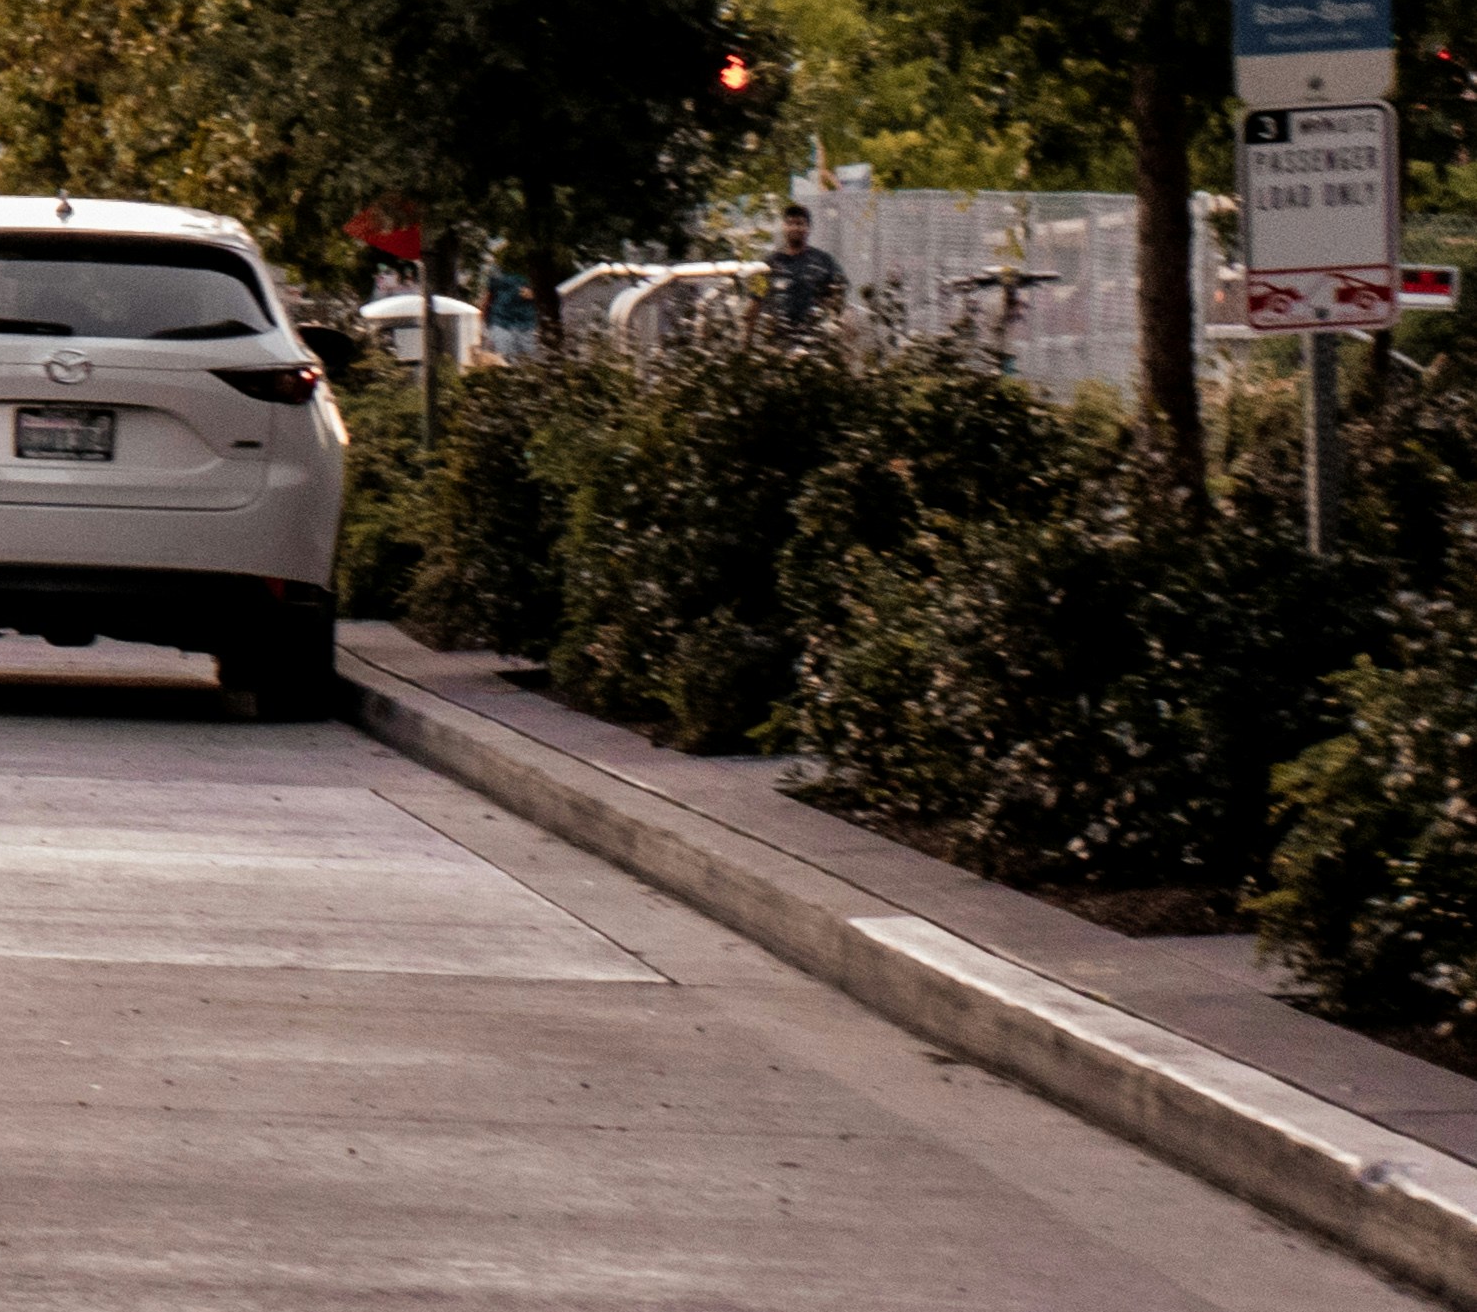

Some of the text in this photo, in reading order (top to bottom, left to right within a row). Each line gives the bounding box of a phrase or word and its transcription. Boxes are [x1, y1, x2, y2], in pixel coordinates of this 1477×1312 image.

[1256, 114, 1279, 140] 3
[1254, 145, 1377, 175] PASSENGER
[1255, 181, 1374, 211] LOAD ONLY
